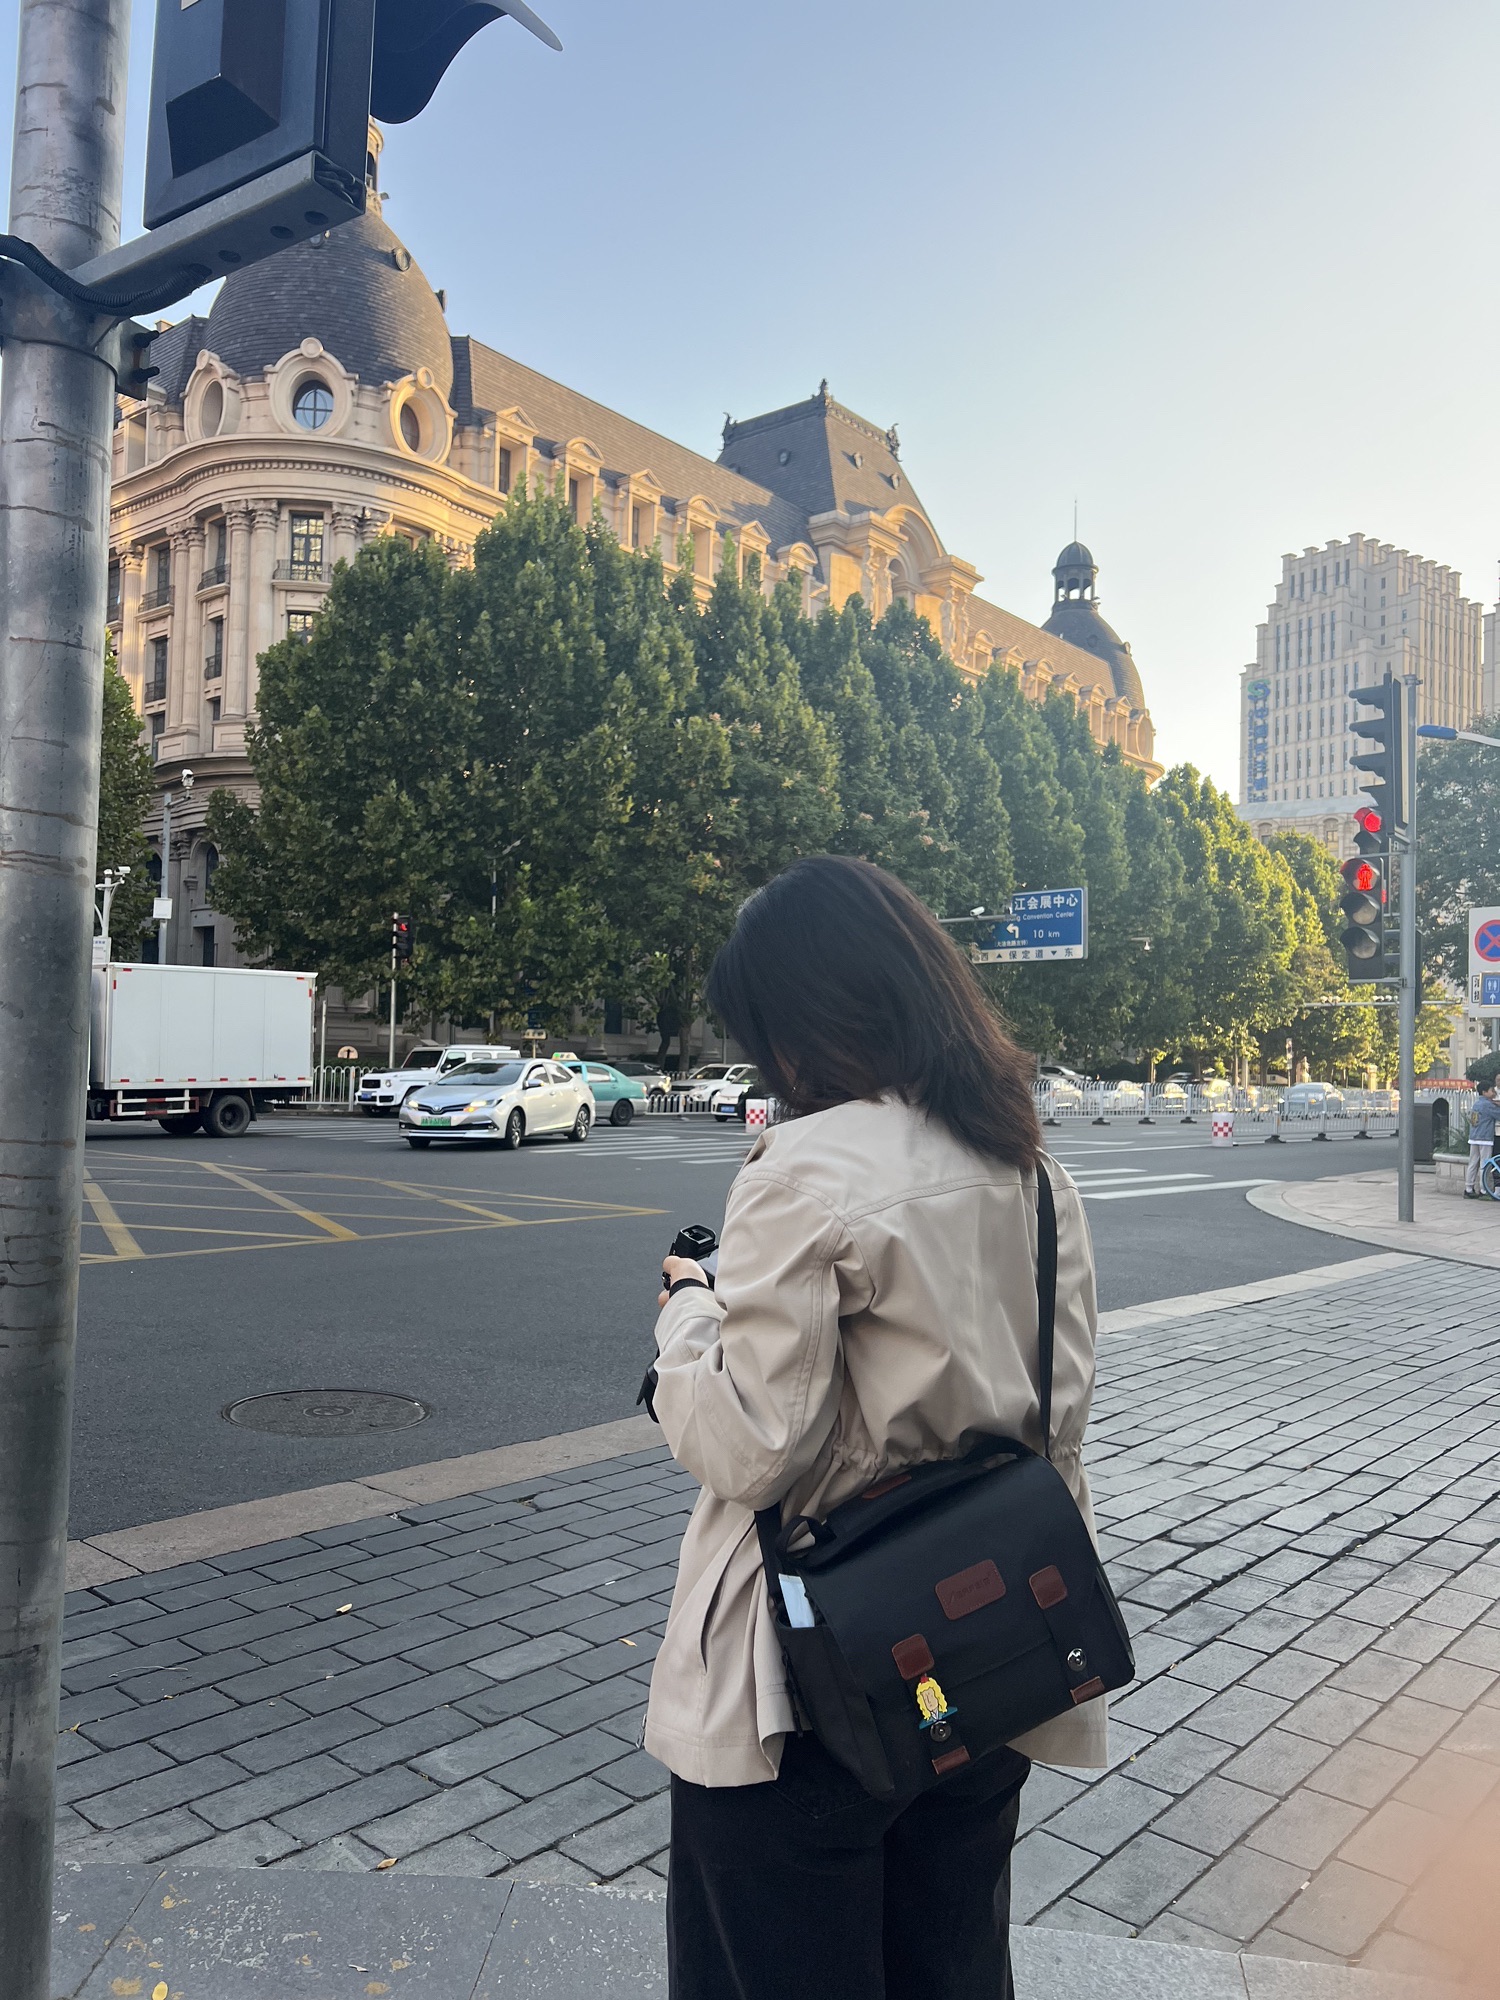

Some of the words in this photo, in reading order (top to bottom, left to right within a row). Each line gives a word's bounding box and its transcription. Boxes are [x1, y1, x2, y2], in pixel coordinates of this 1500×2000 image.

[1014, 894, 1078, 911] 江会展中心
[1033, 929, 1044, 939] 10
[1048, 930, 1060, 938] km
[981, 952, 989, 961] 西
[1009, 949, 1044, 960] 保定道
[1064, 948, 1073, 957] 东
